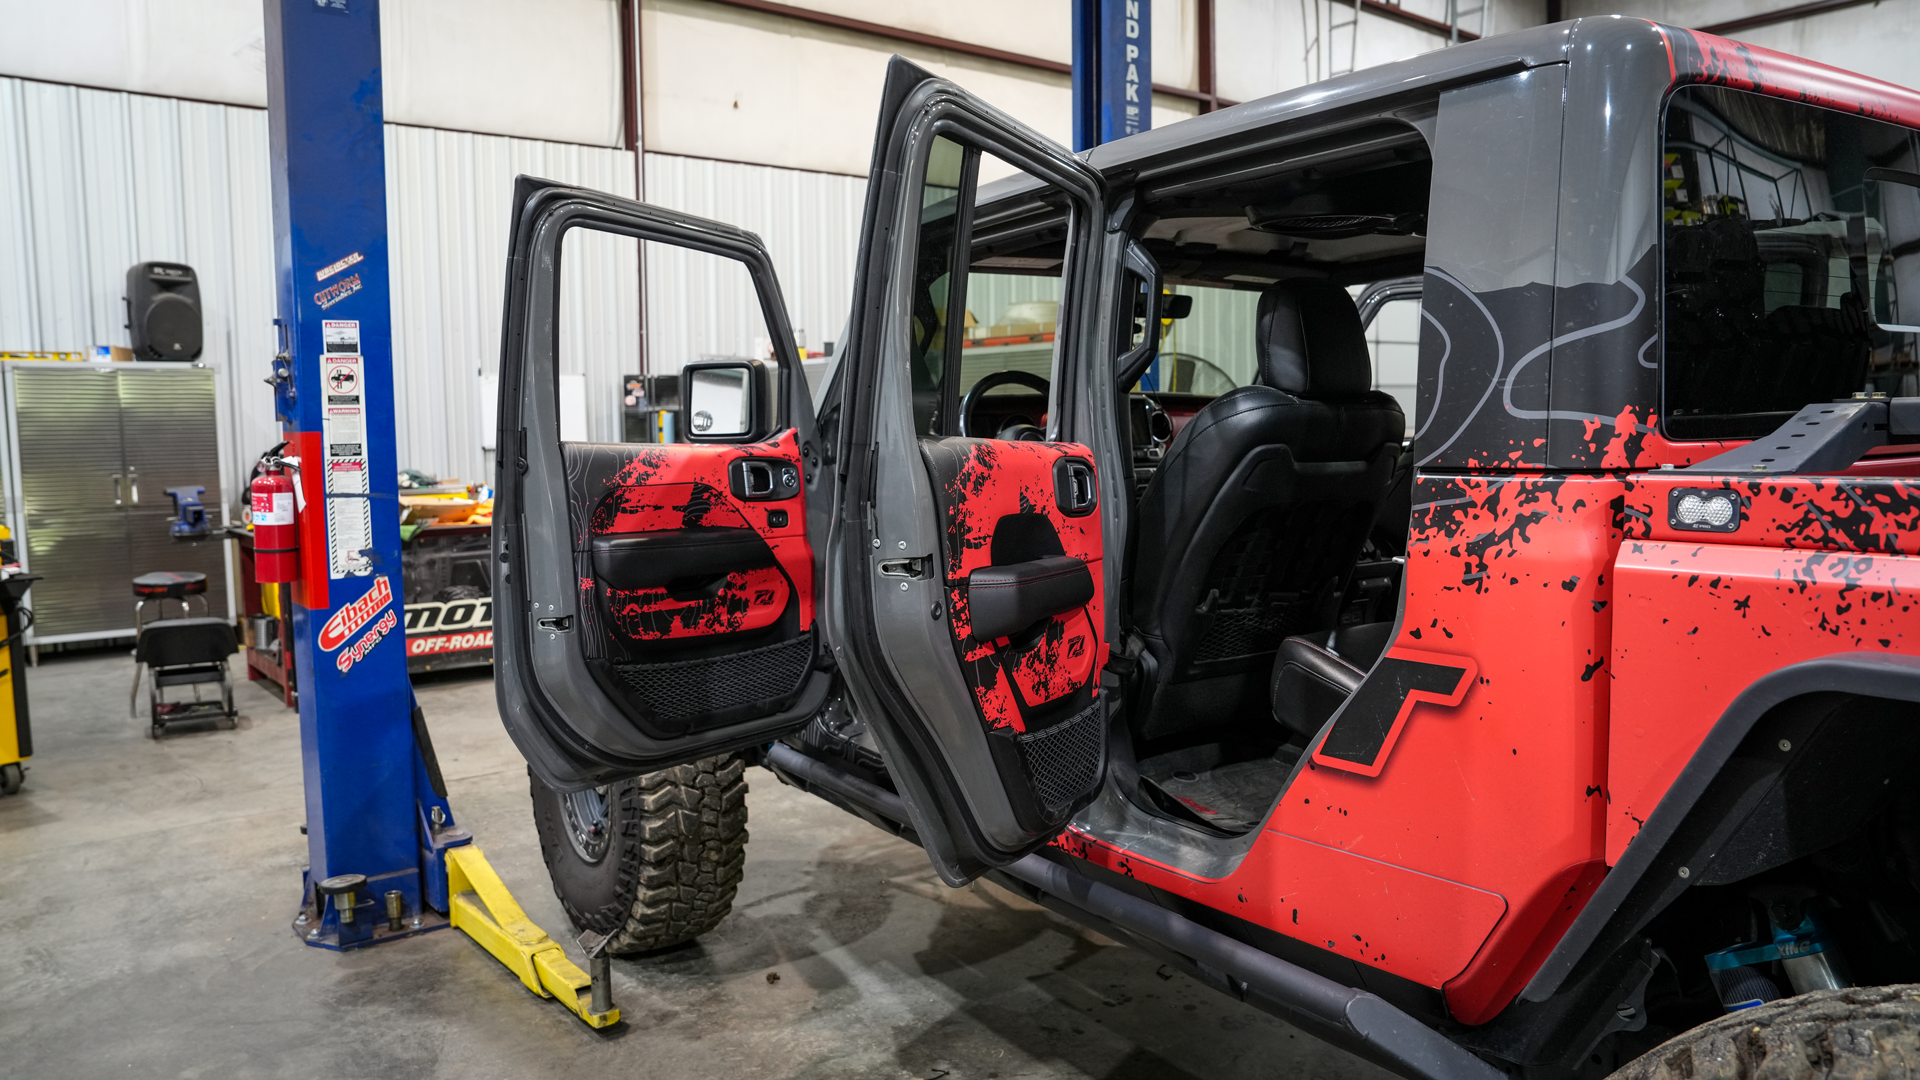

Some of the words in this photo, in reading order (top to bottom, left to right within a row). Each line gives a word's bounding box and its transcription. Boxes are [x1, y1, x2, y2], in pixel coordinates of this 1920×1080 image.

[1126, 44, 1139, 103] PAK
[319, 577, 390, 650] Eibach
[338, 609, 397, 673] Synergy
[1778, 940, 1810, 956] KING
